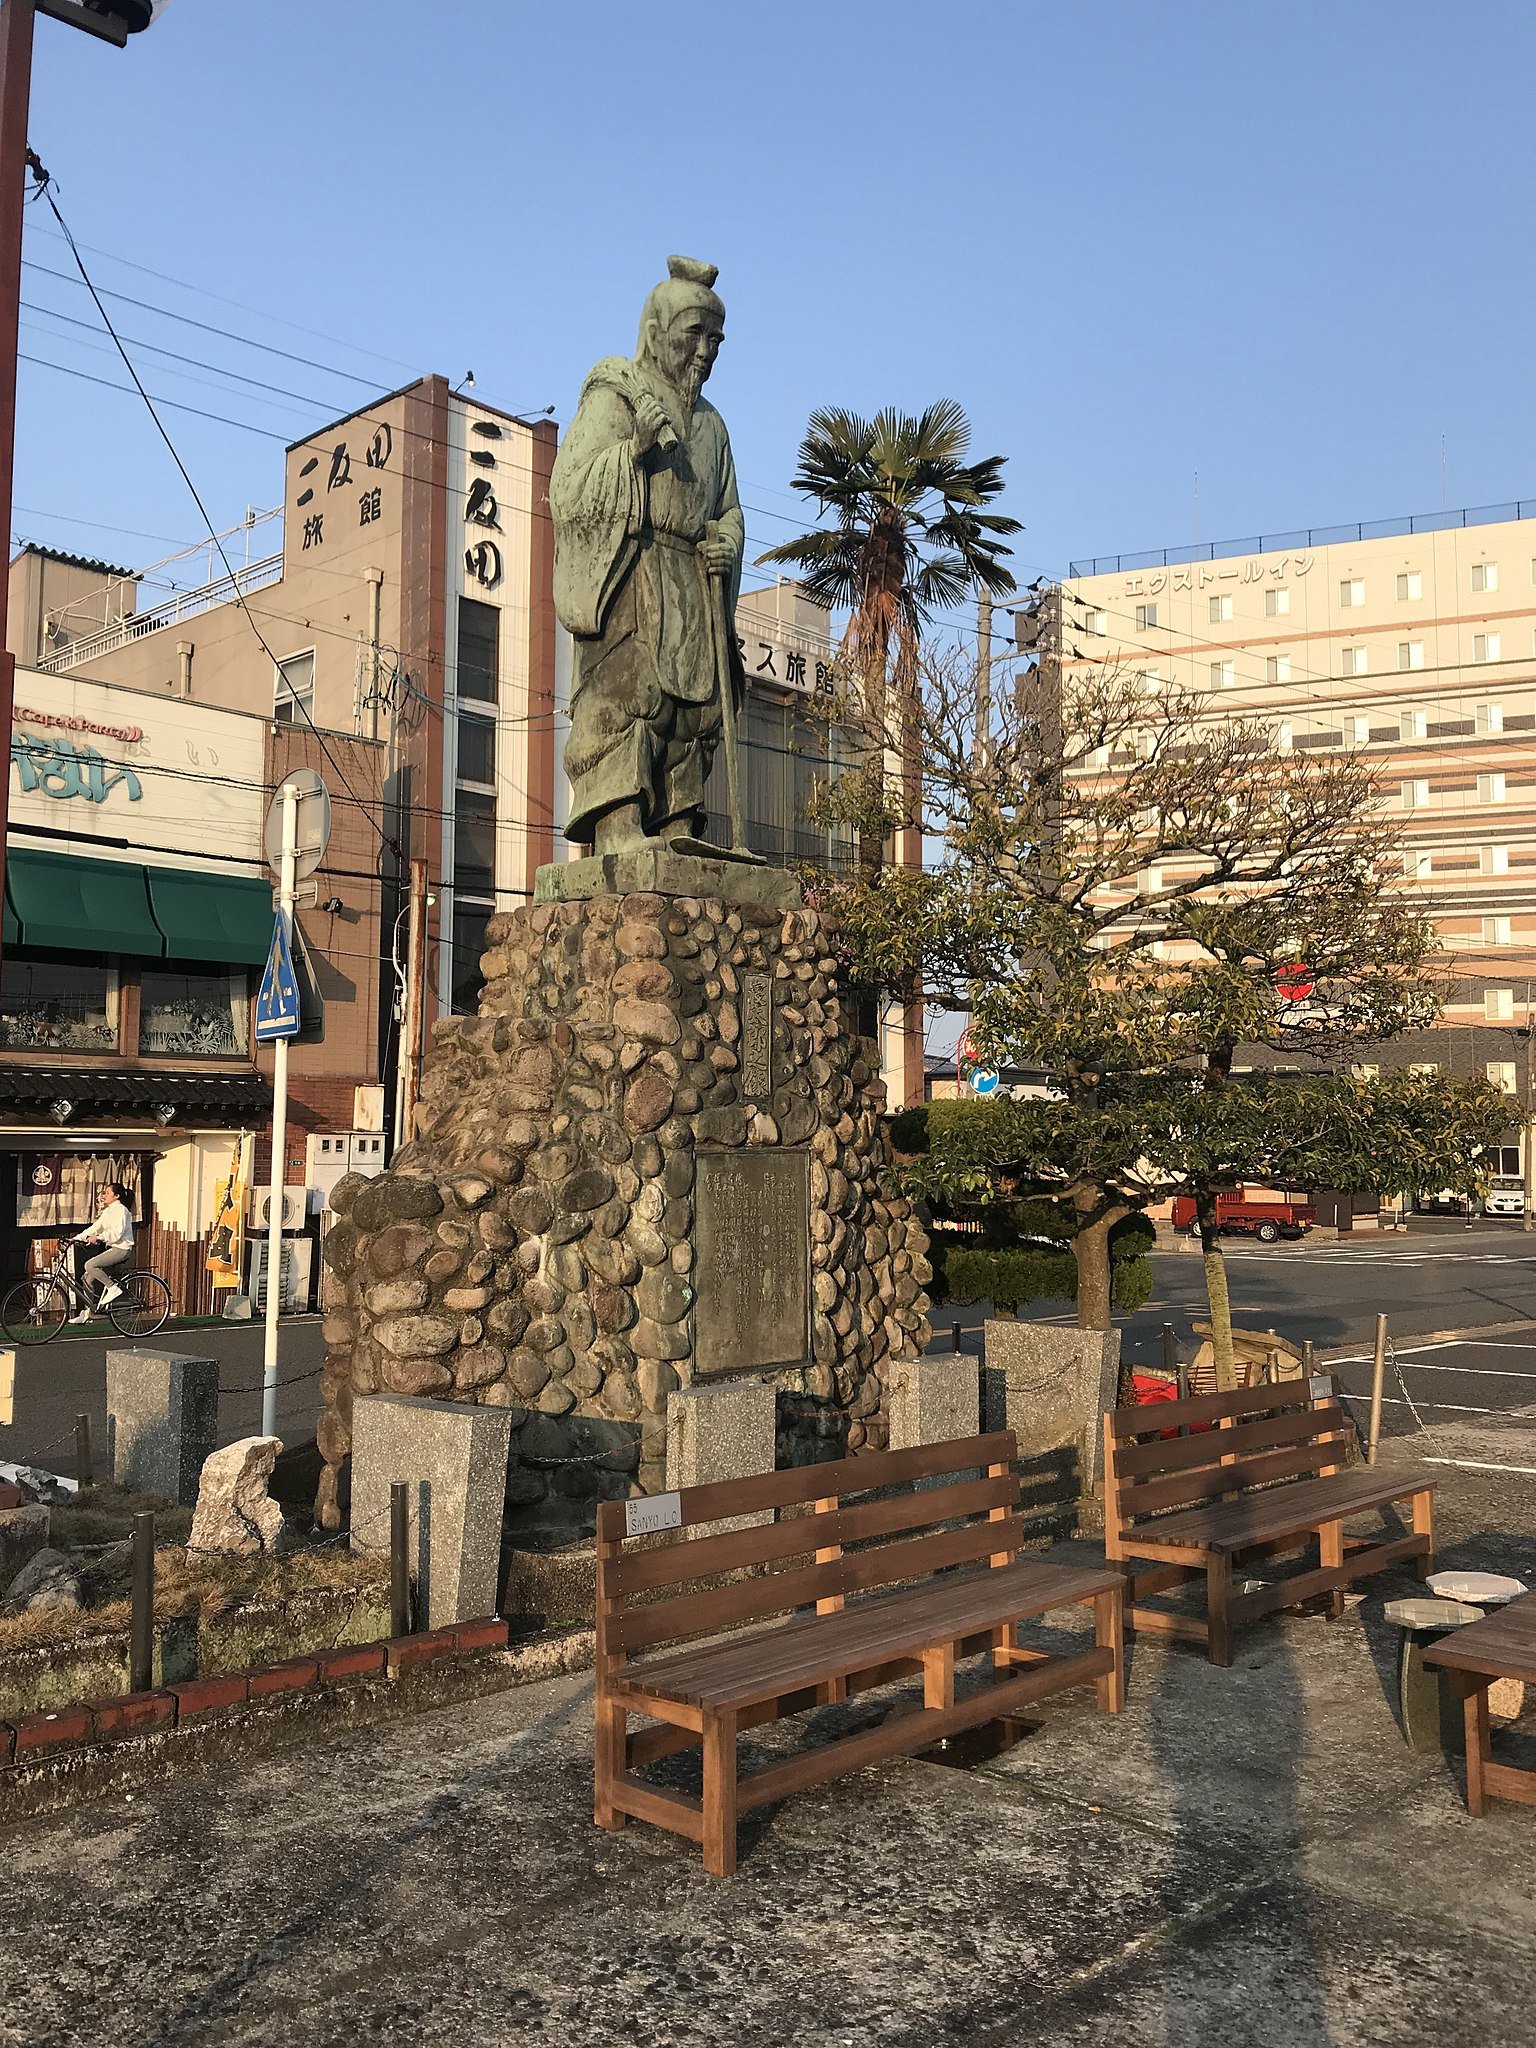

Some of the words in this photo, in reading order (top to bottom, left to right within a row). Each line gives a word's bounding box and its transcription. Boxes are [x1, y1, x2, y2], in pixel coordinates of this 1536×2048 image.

[302, 486, 382, 551] 旅館
[1125, 556, 1314, 597] エクストールイン
[629, 1503, 638, 1514] 55
